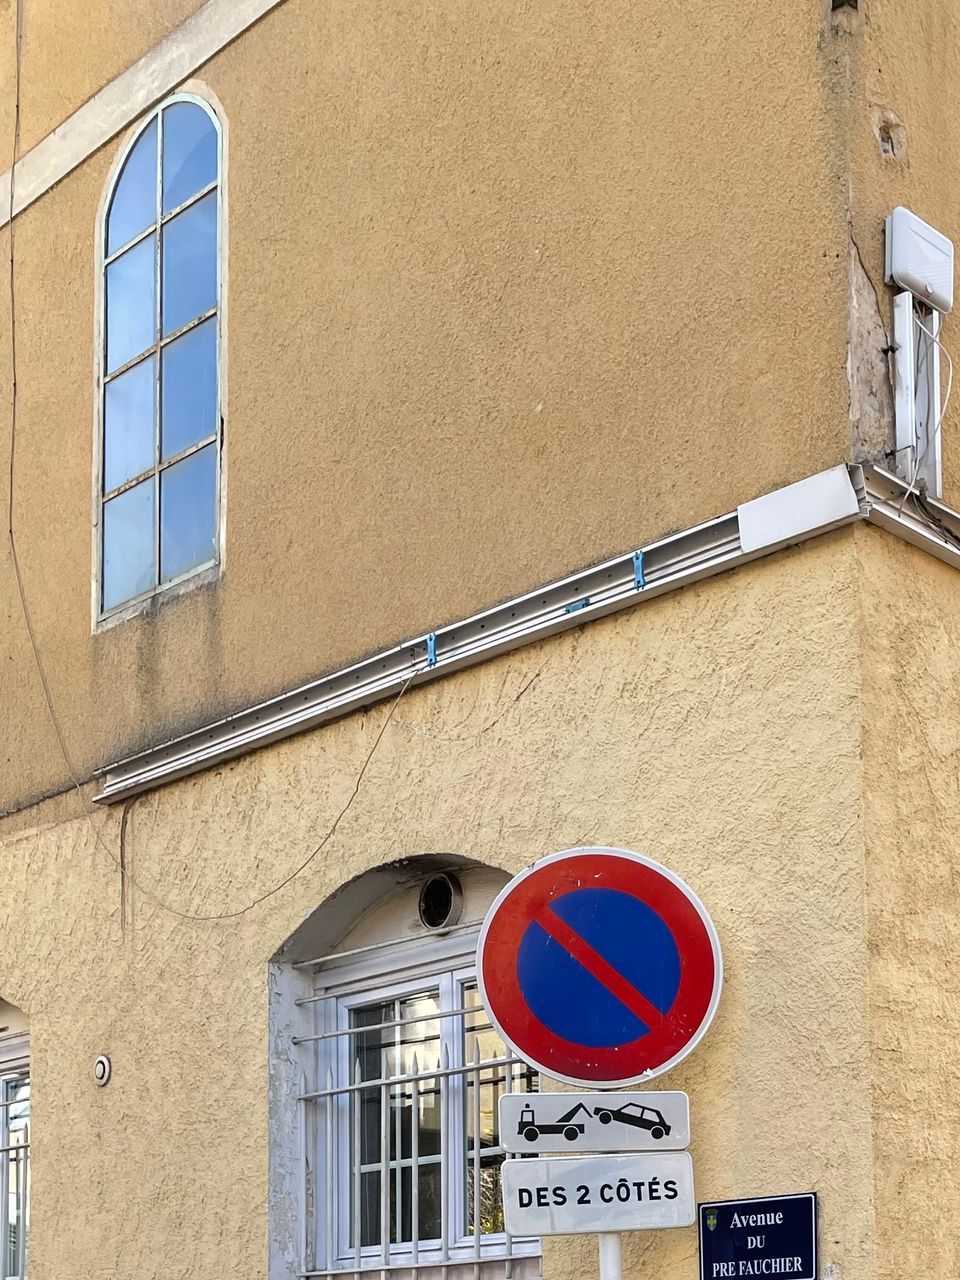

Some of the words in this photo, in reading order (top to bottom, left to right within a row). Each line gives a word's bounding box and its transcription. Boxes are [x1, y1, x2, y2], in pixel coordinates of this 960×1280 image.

[518, 1186, 567, 1208] DES
[576, 1185, 591, 1205] 2
[599, 1177, 679, 1203] CÔTÉS
[729, 1211, 784, 1229] Avenue
[746, 1236, 765, 1249] DU
[712, 1261, 736, 1278] PRE
[738, 1257, 803, 1276] FAUCHIER
